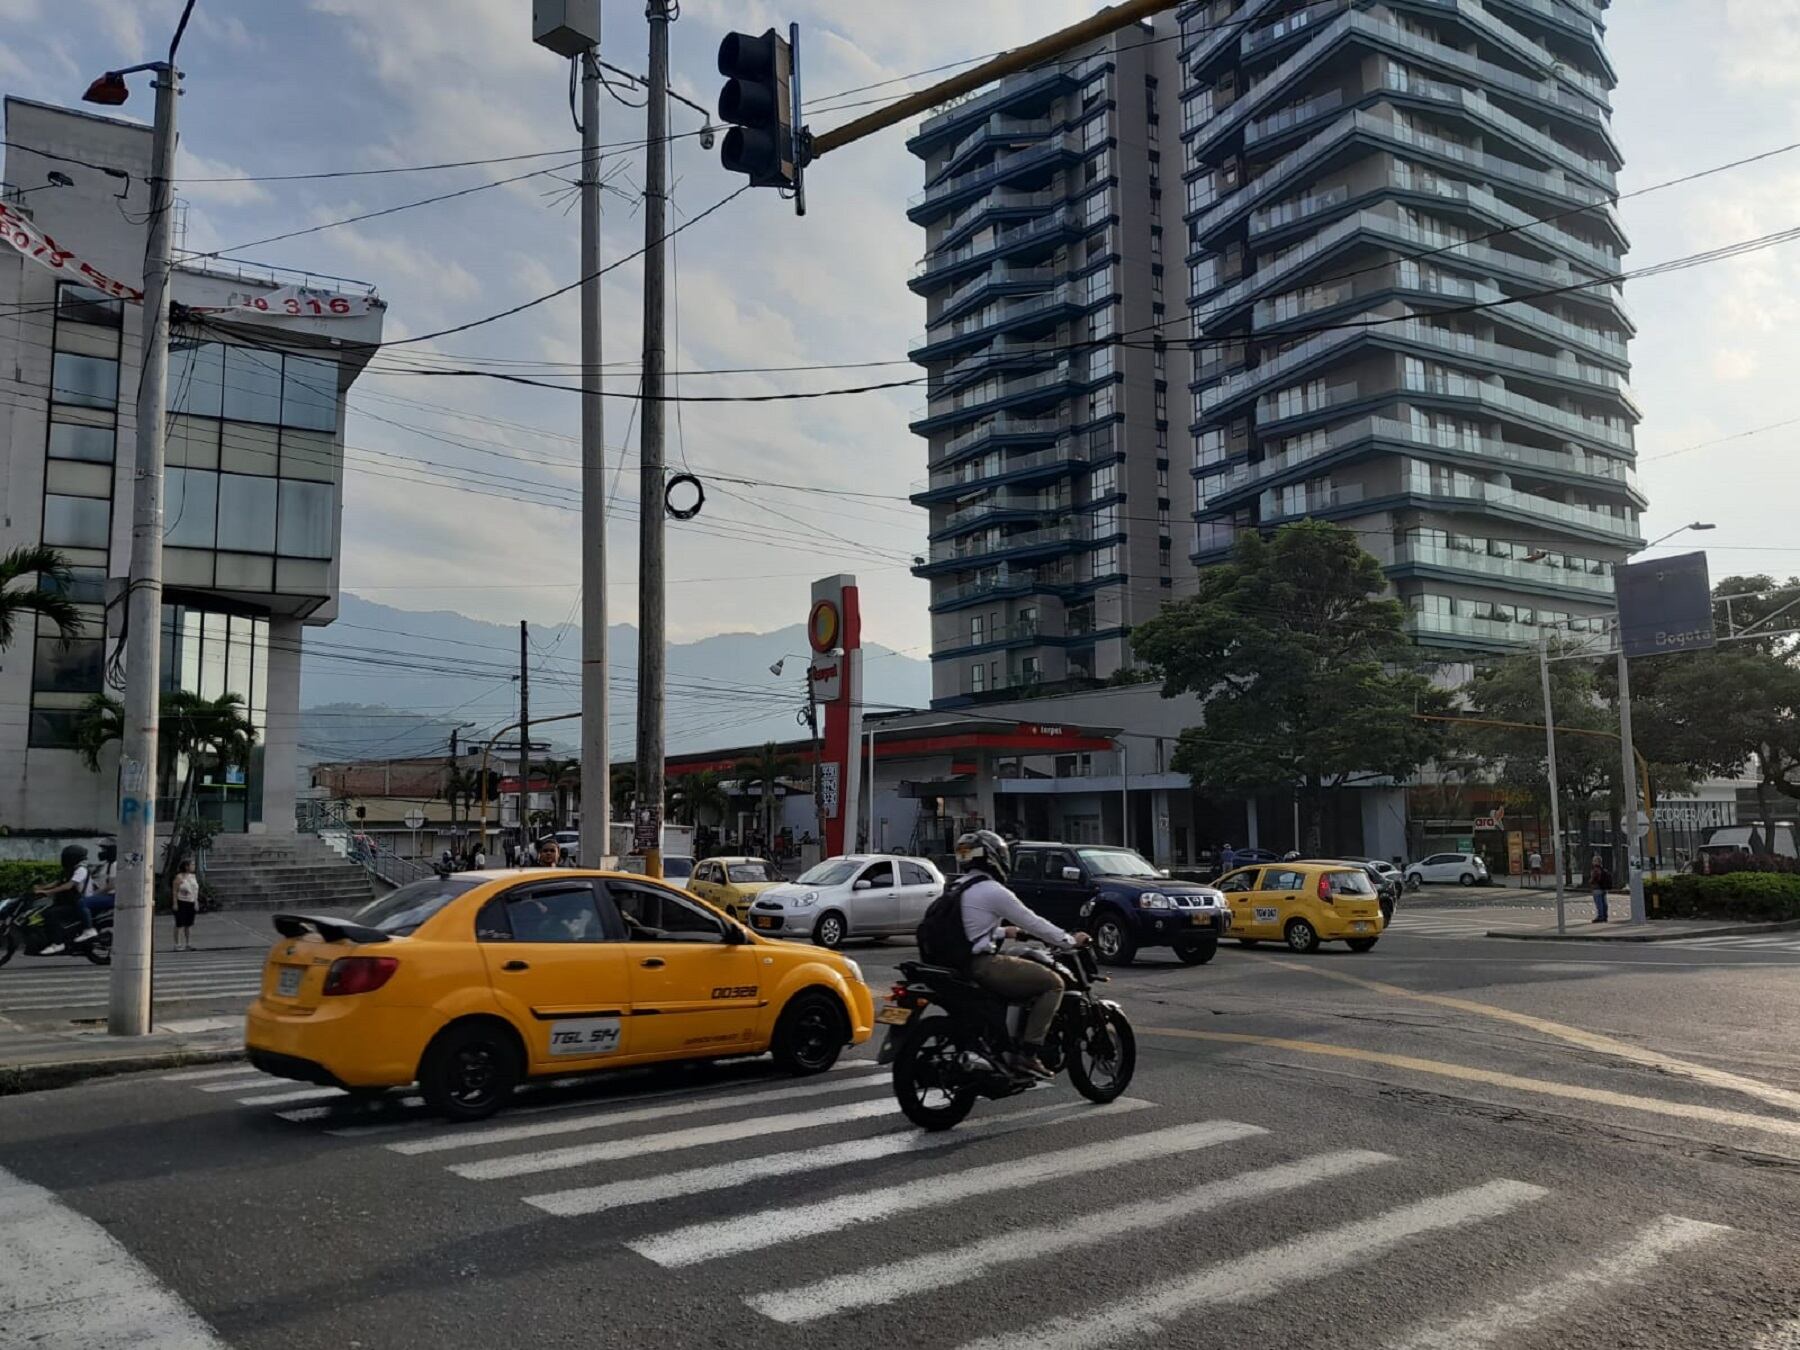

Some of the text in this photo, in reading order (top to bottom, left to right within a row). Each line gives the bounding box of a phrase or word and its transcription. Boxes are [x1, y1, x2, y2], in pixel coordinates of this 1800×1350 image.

[284, 297, 350, 314] 316
[1475, 818, 1495, 827] ara
[552, 1031, 584, 1045] TGL
